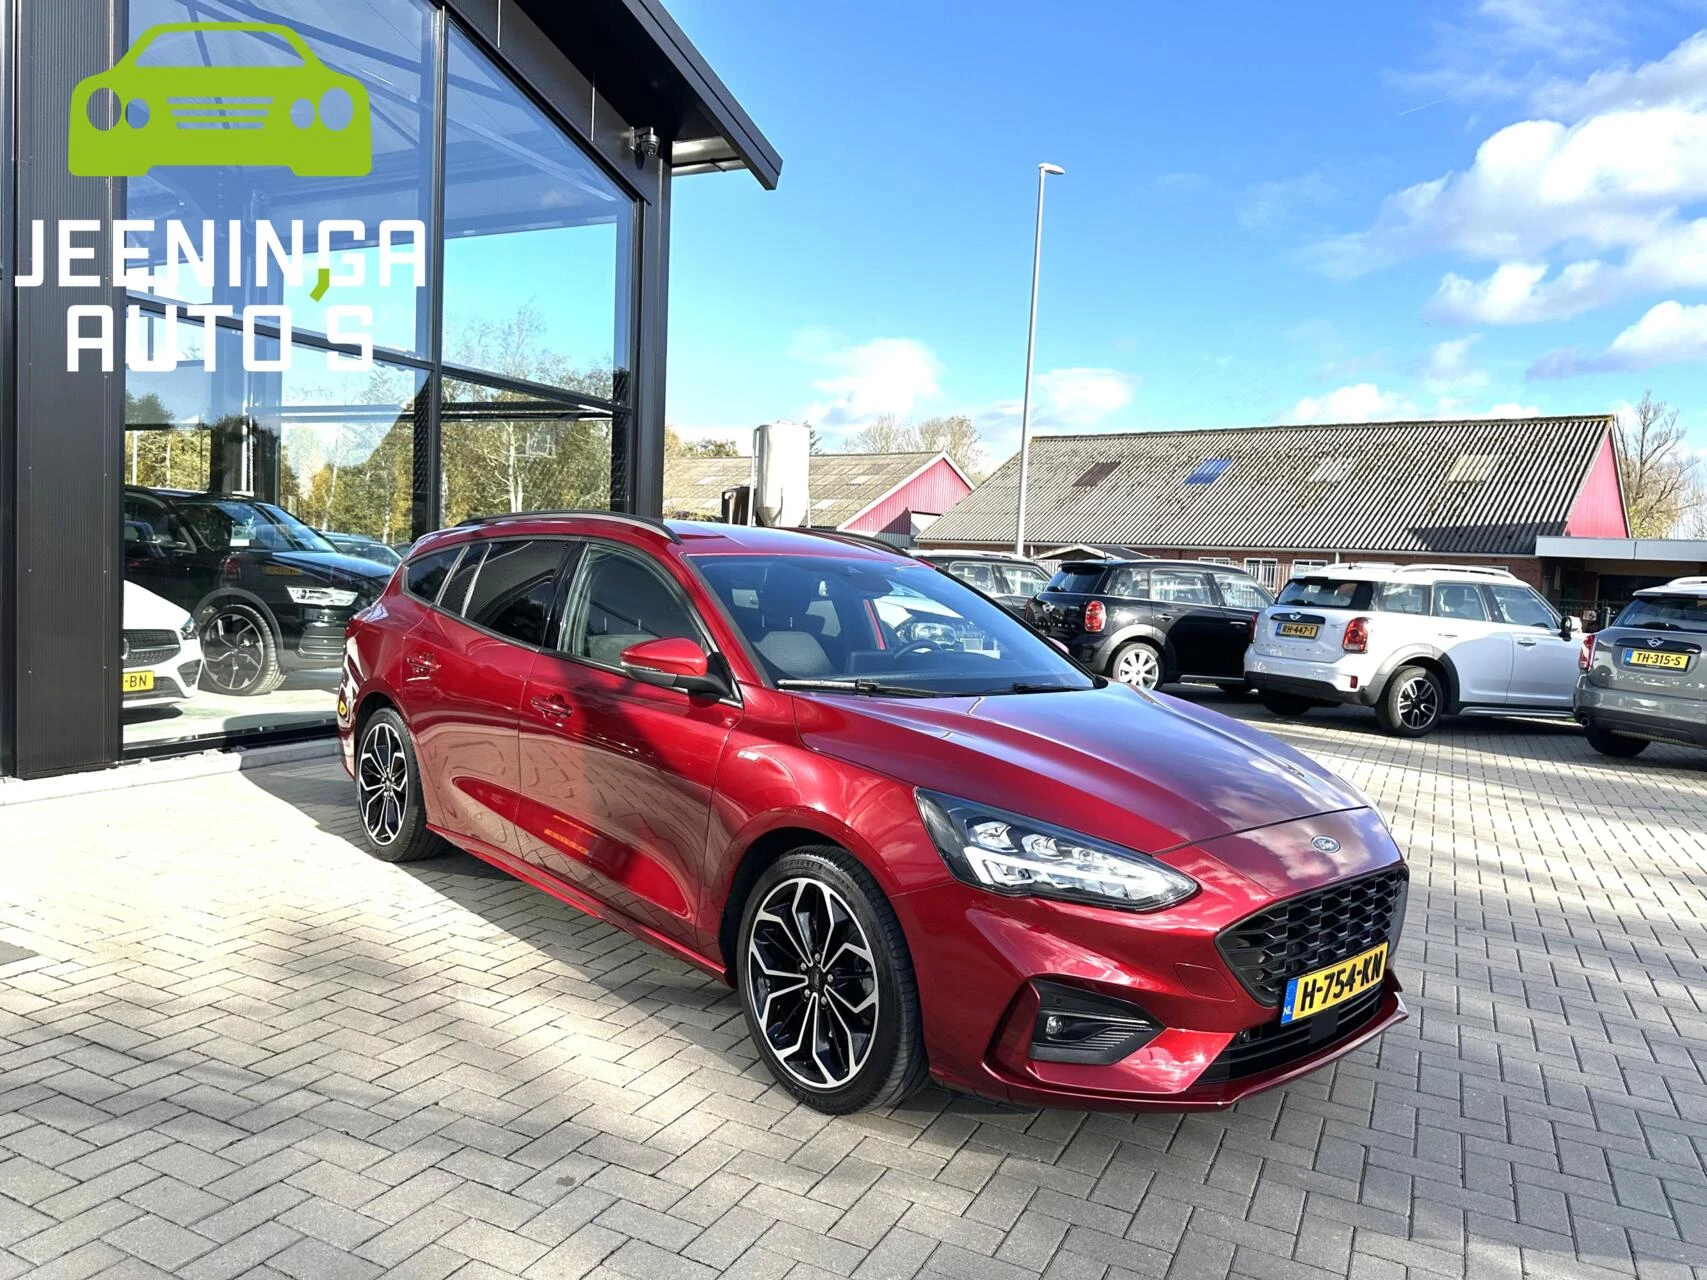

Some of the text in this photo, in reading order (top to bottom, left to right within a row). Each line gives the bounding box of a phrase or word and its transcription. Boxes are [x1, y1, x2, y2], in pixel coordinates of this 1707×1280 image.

[1281, 625, 1316, 636] RH-447-T
[1636, 652, 1682, 666] TH-315-S
[125, 674, 147, 688] -BN
[1282, 950, 1384, 1017] NL H-754-KN
